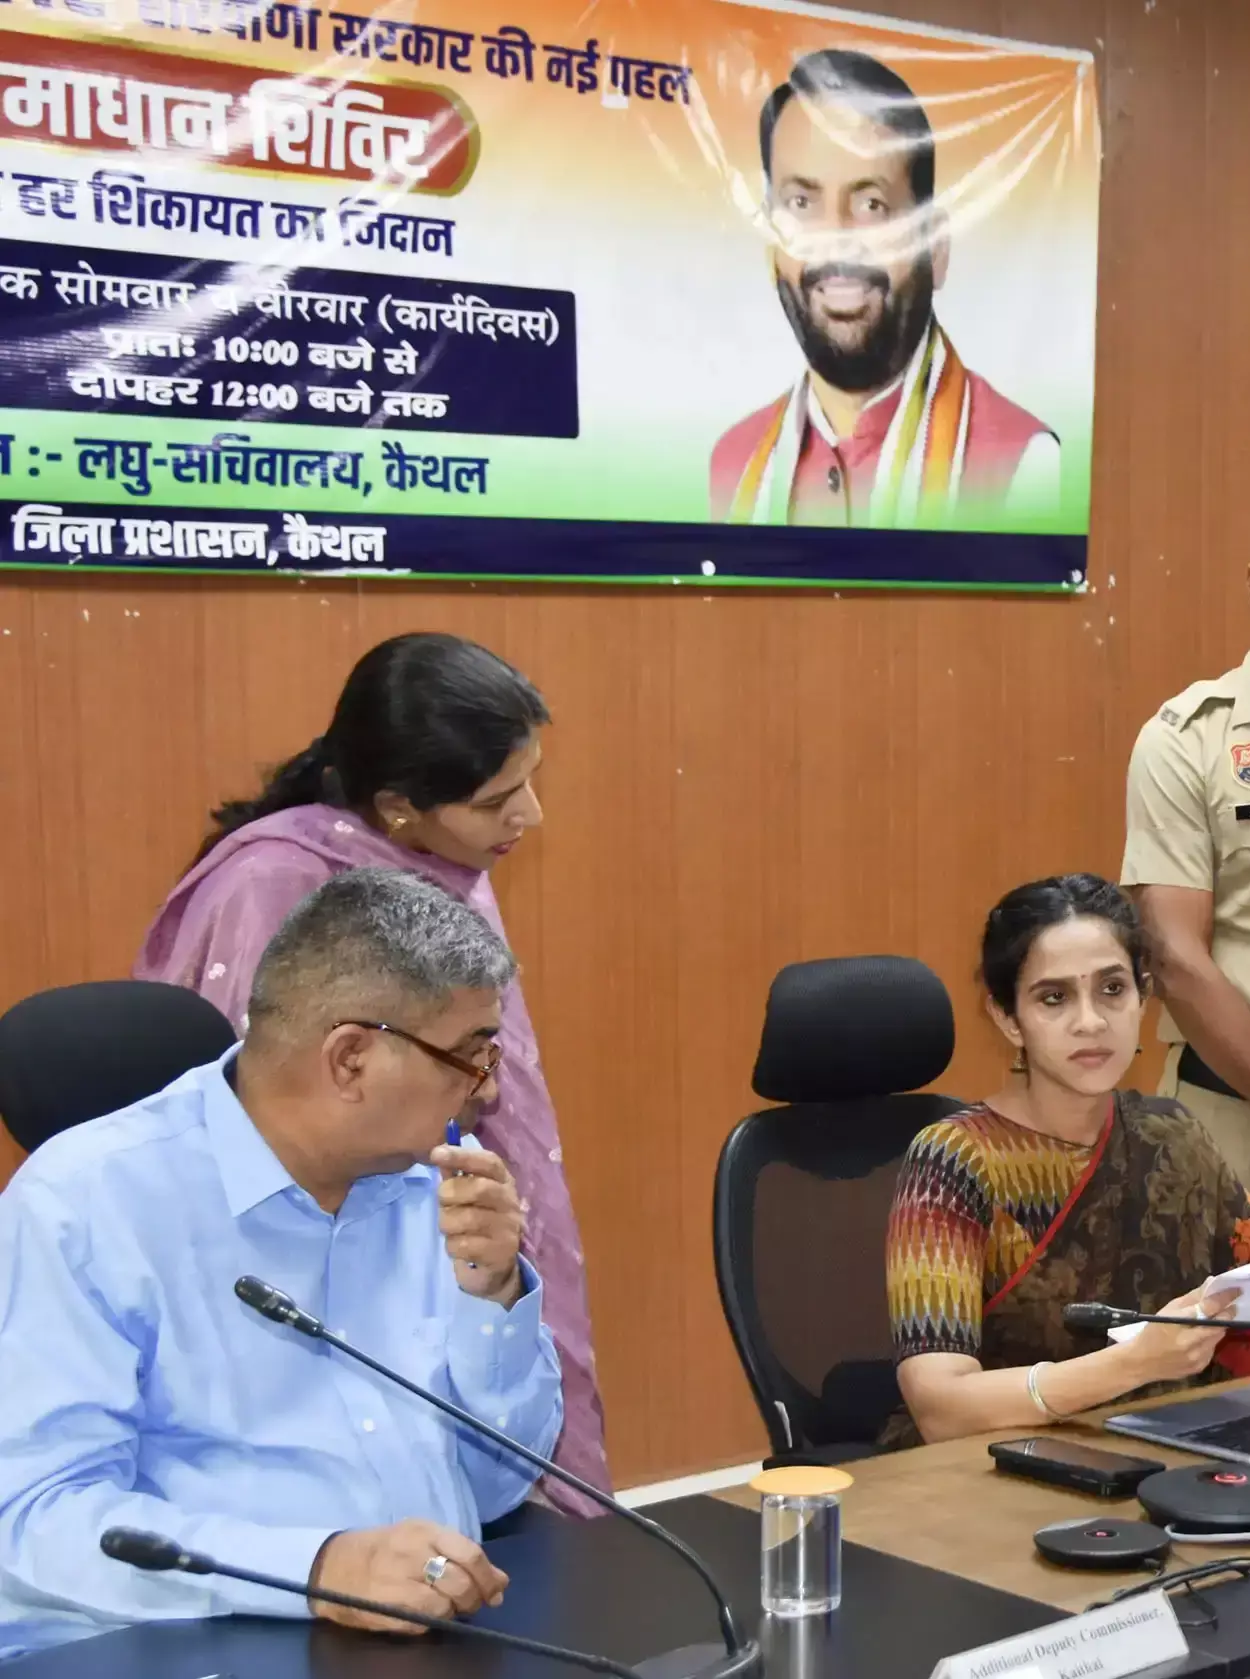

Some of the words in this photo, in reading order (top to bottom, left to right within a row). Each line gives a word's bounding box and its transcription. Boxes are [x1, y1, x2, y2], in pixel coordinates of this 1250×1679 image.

[329, 12, 475, 74] सरकार
[481, 26, 536, 82] की
[542, 39, 601, 94] नई
[609, 55, 693, 105] पहल
[0, 61, 233, 156] माधान
[241, 78, 430, 180] शिविर
[12, 172, 77, 220] हर
[88, 170, 263, 239] शिकायत
[271, 201, 326, 242] का
[51, 260, 196, 312] सोमवार
[250, 279, 369, 328] वीरवार
[377, 293, 560, 346] (कार्यदिवस)
[212, 336, 300, 366] 10:00
[308, 337, 375, 372] बजे
[383, 340, 418, 375] से
[67, 362, 203, 406] दोपहर
[211, 381, 299, 410] 12:00
[307, 380, 374, 415] बजे
[381, 391, 450, 419] तक
[74, 433, 373, 497] लघु-सचिवालय,
[381, 440, 490, 495] कैथल
[10, 503, 117, 555] जिला
[120, 518, 279, 567] प्रशासन,
[283, 513, 387, 562] कैथल
[969, 1647, 1034, 1679] Additional
[1034, 1636, 1077, 1660] Deputy
